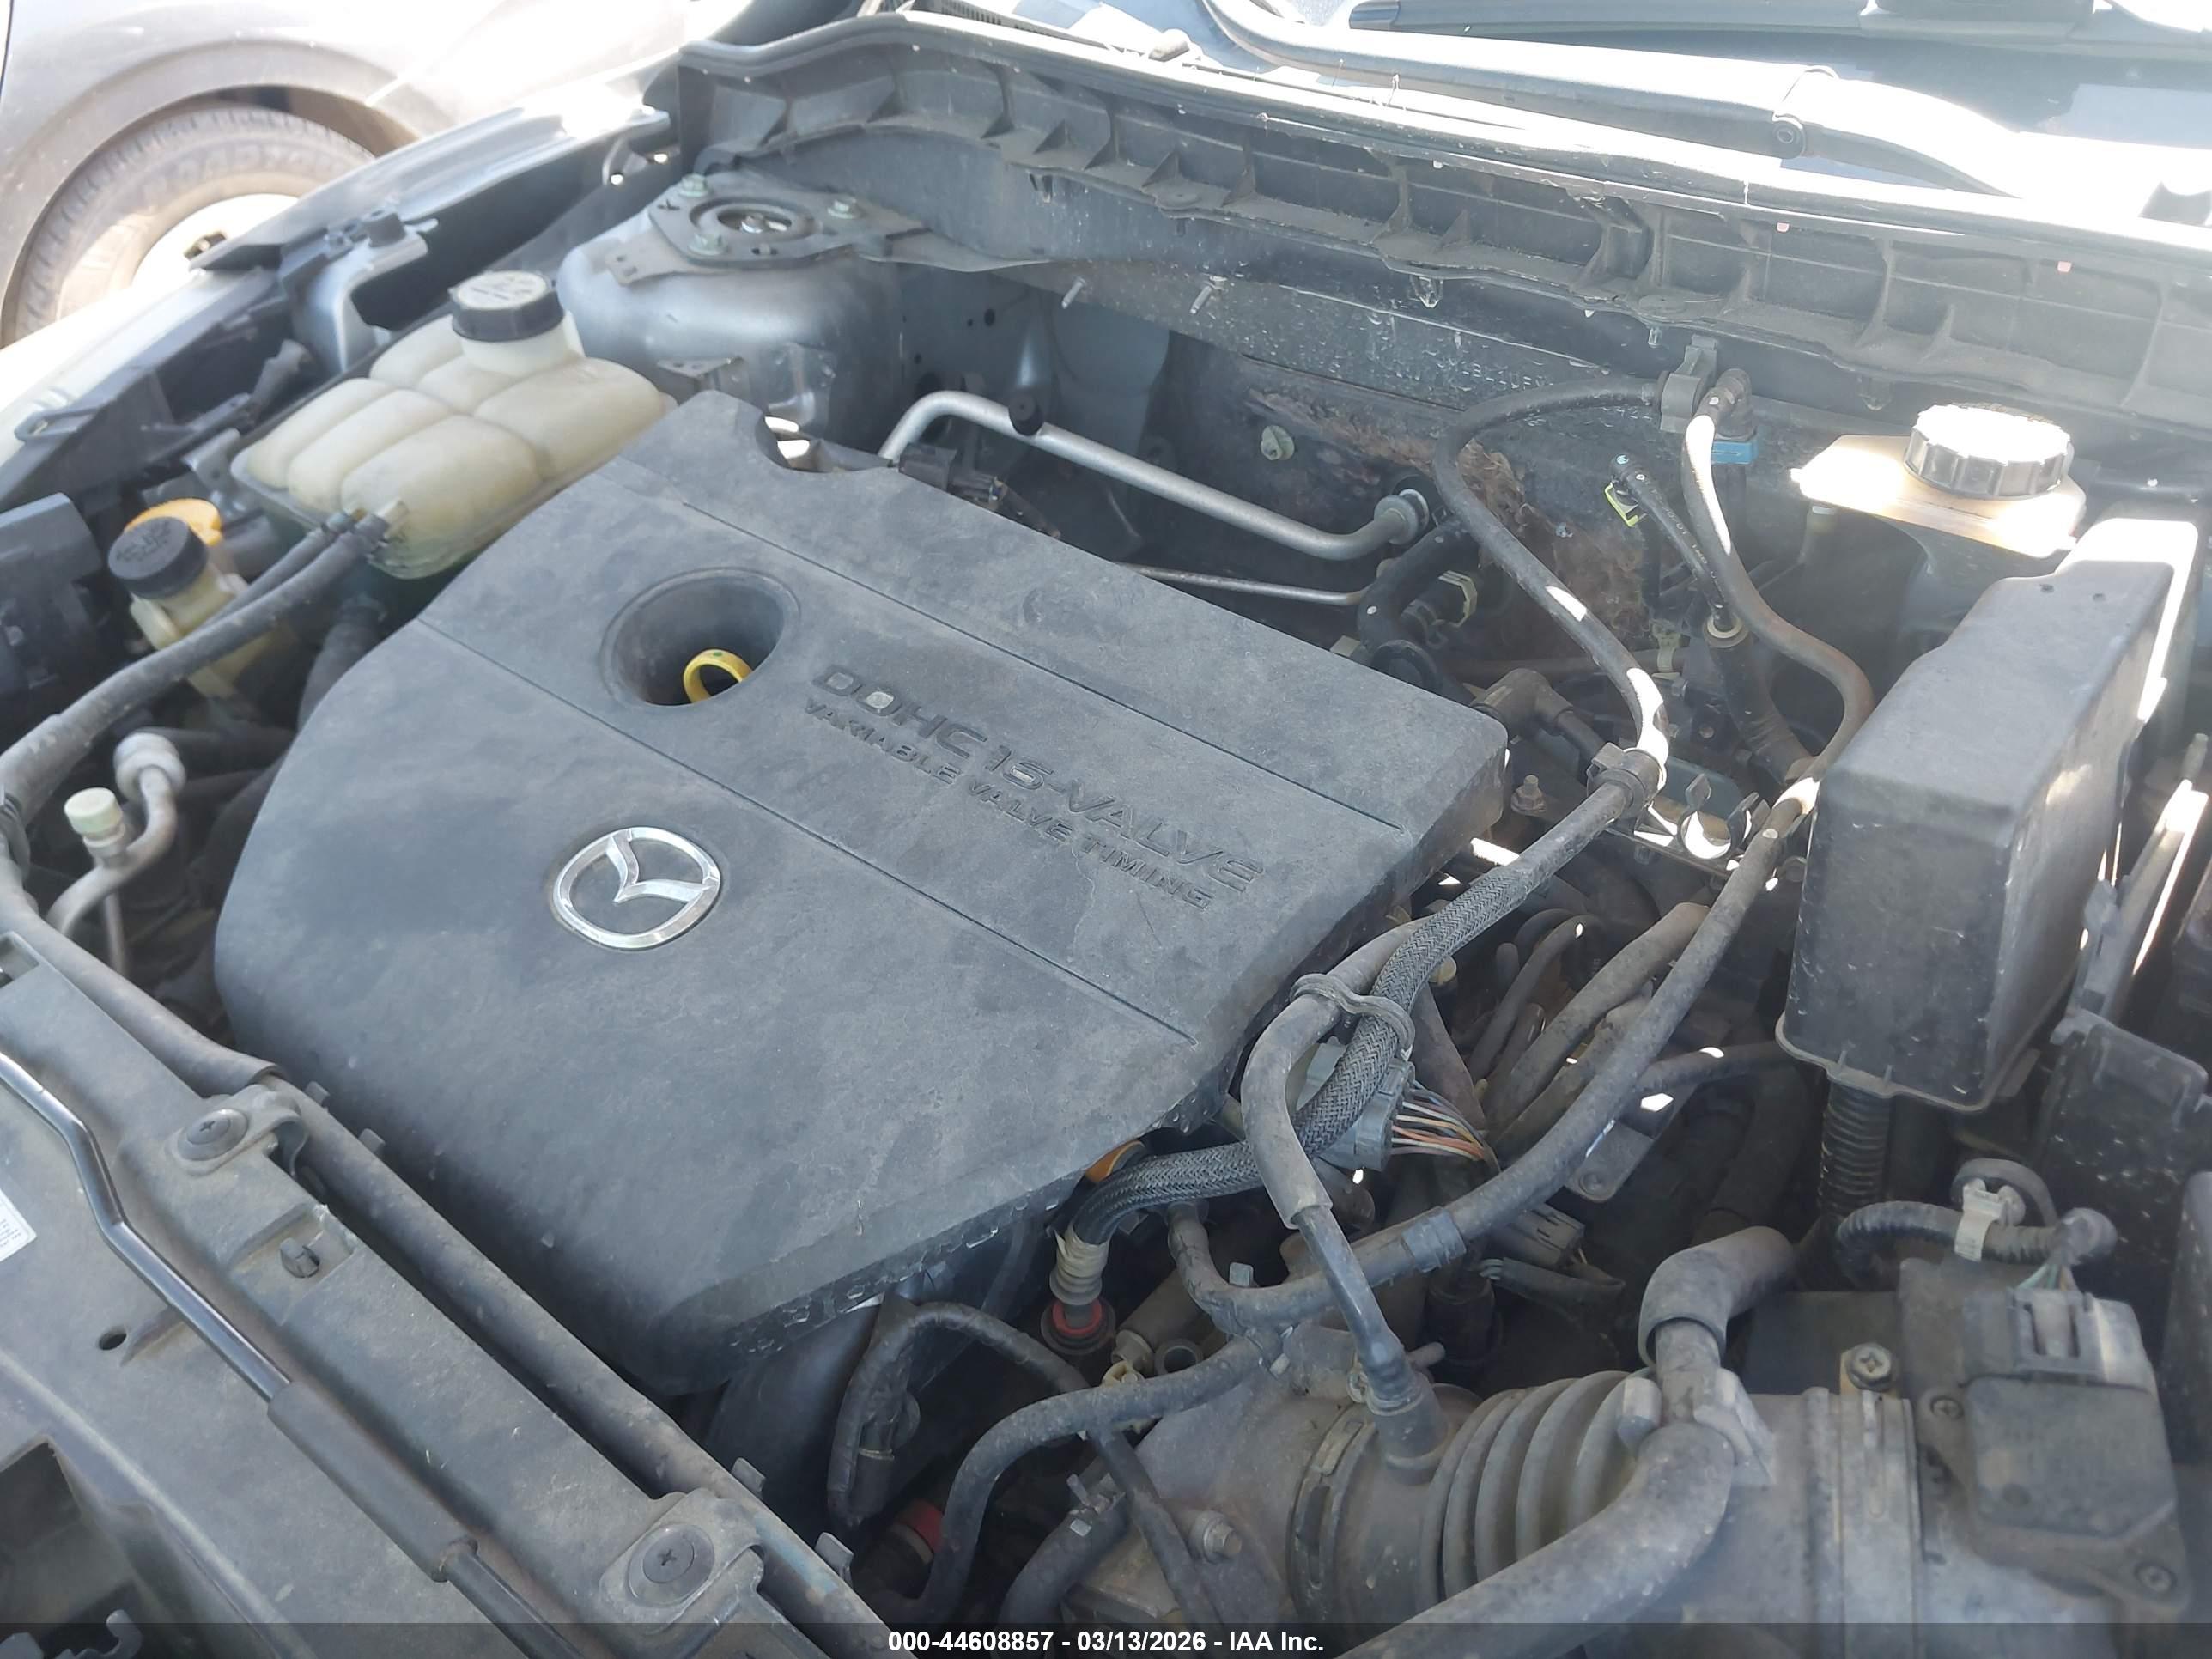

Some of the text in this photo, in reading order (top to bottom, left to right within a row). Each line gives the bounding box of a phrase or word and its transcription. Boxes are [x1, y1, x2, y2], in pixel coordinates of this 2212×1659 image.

[812, 665, 987, 758] DOHC
[804, 699, 1213, 911] VARIABLE VALVE TIMING
